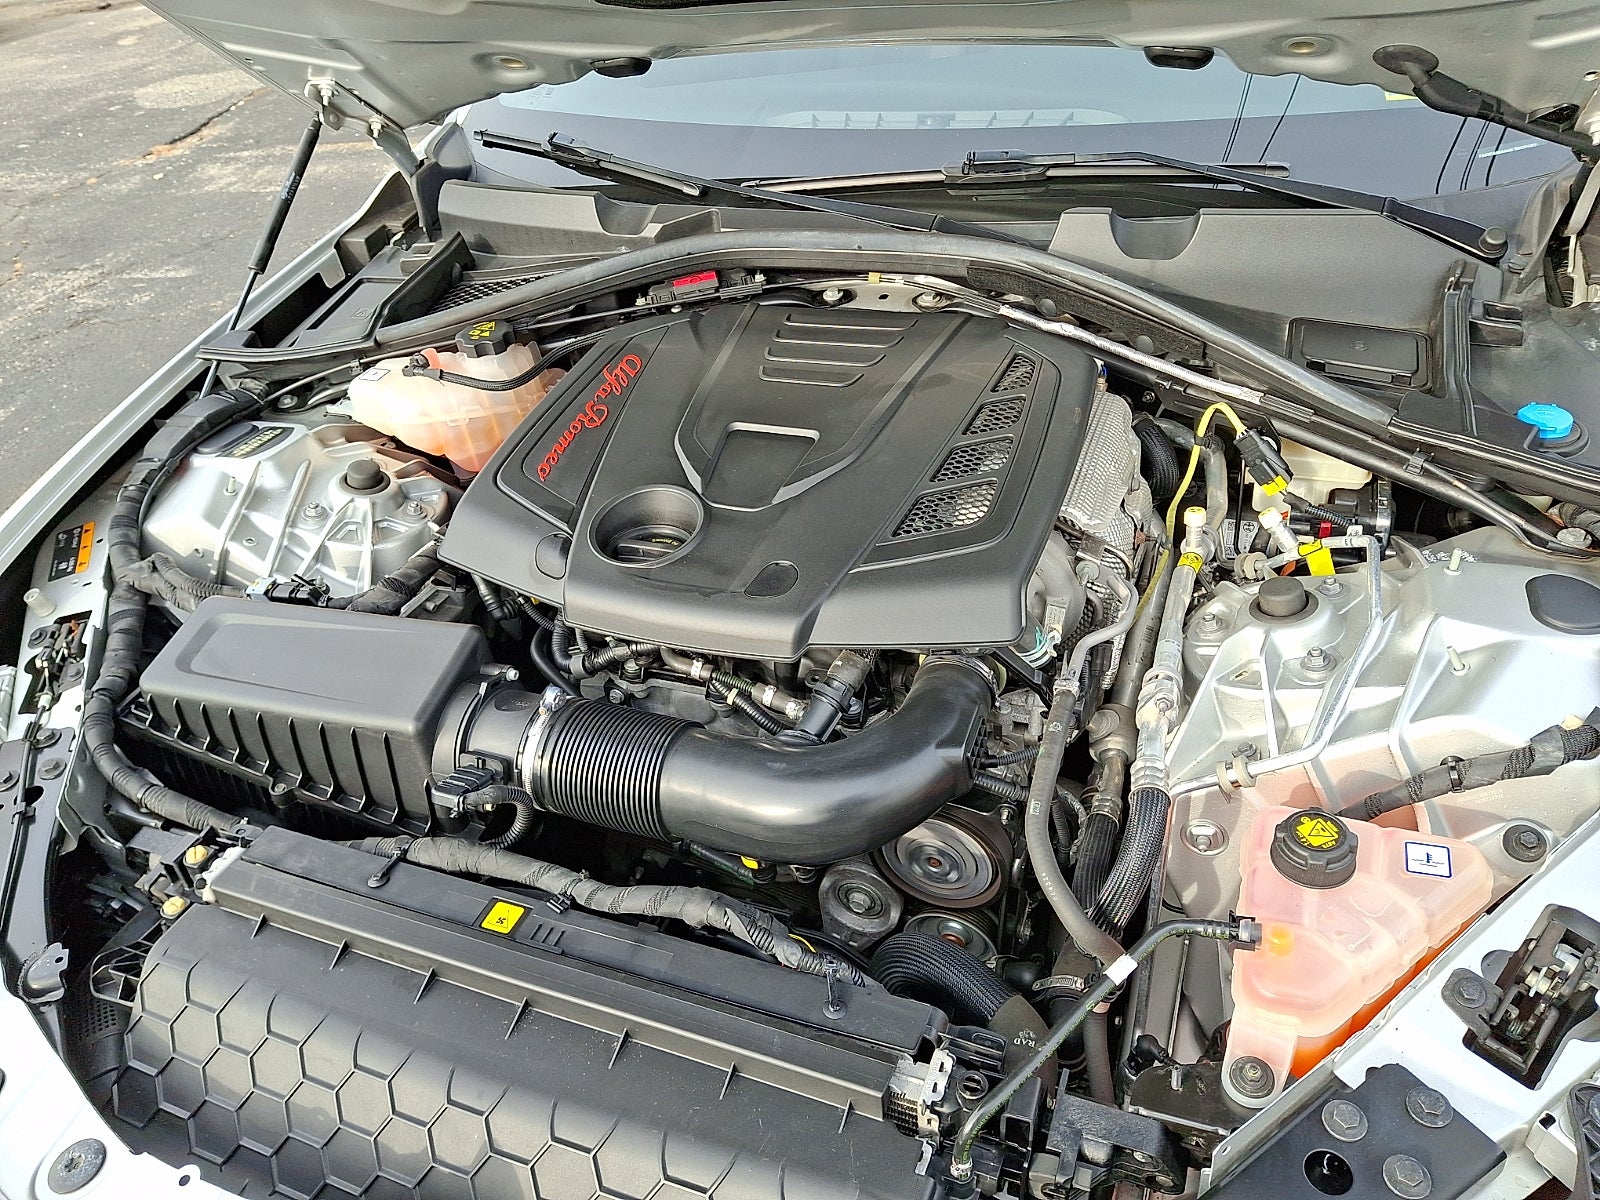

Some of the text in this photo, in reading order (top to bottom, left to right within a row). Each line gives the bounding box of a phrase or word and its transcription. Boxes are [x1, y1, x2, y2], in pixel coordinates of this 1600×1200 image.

[537, 353, 642, 482] Alfa Romeo
[1013, 1037, 1036, 1048] RAD
